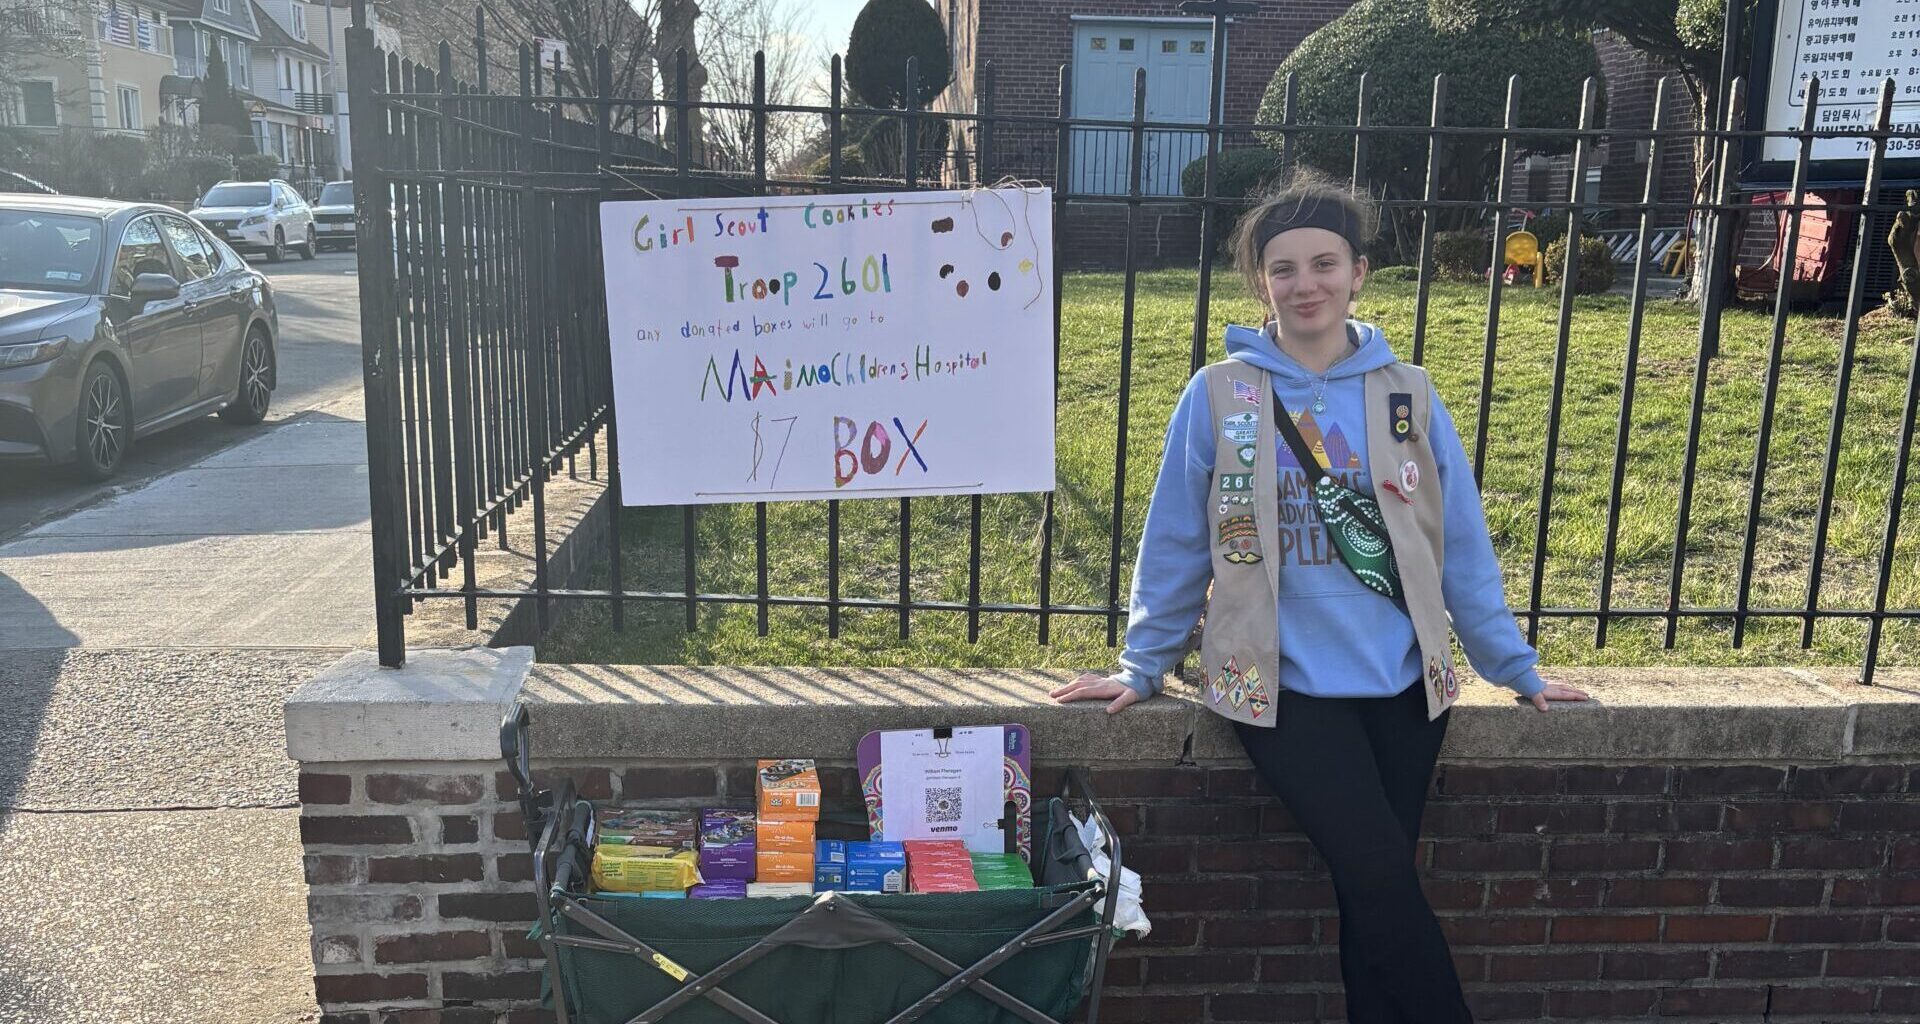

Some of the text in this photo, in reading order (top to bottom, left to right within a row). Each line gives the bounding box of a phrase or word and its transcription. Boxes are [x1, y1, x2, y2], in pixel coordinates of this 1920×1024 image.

[1797, 87, 1848, 99] 새기도회
[1822, 109, 1861, 123] 담임목사
[634, 197, 895, 251] Girl Scout Cookies
[714, 252, 892, 306] Troop 2601
[637, 311, 884, 342] any donated boxes will go to
[747, 411, 928, 490] $7 BOX
[930, 825, 958, 833] venmo
